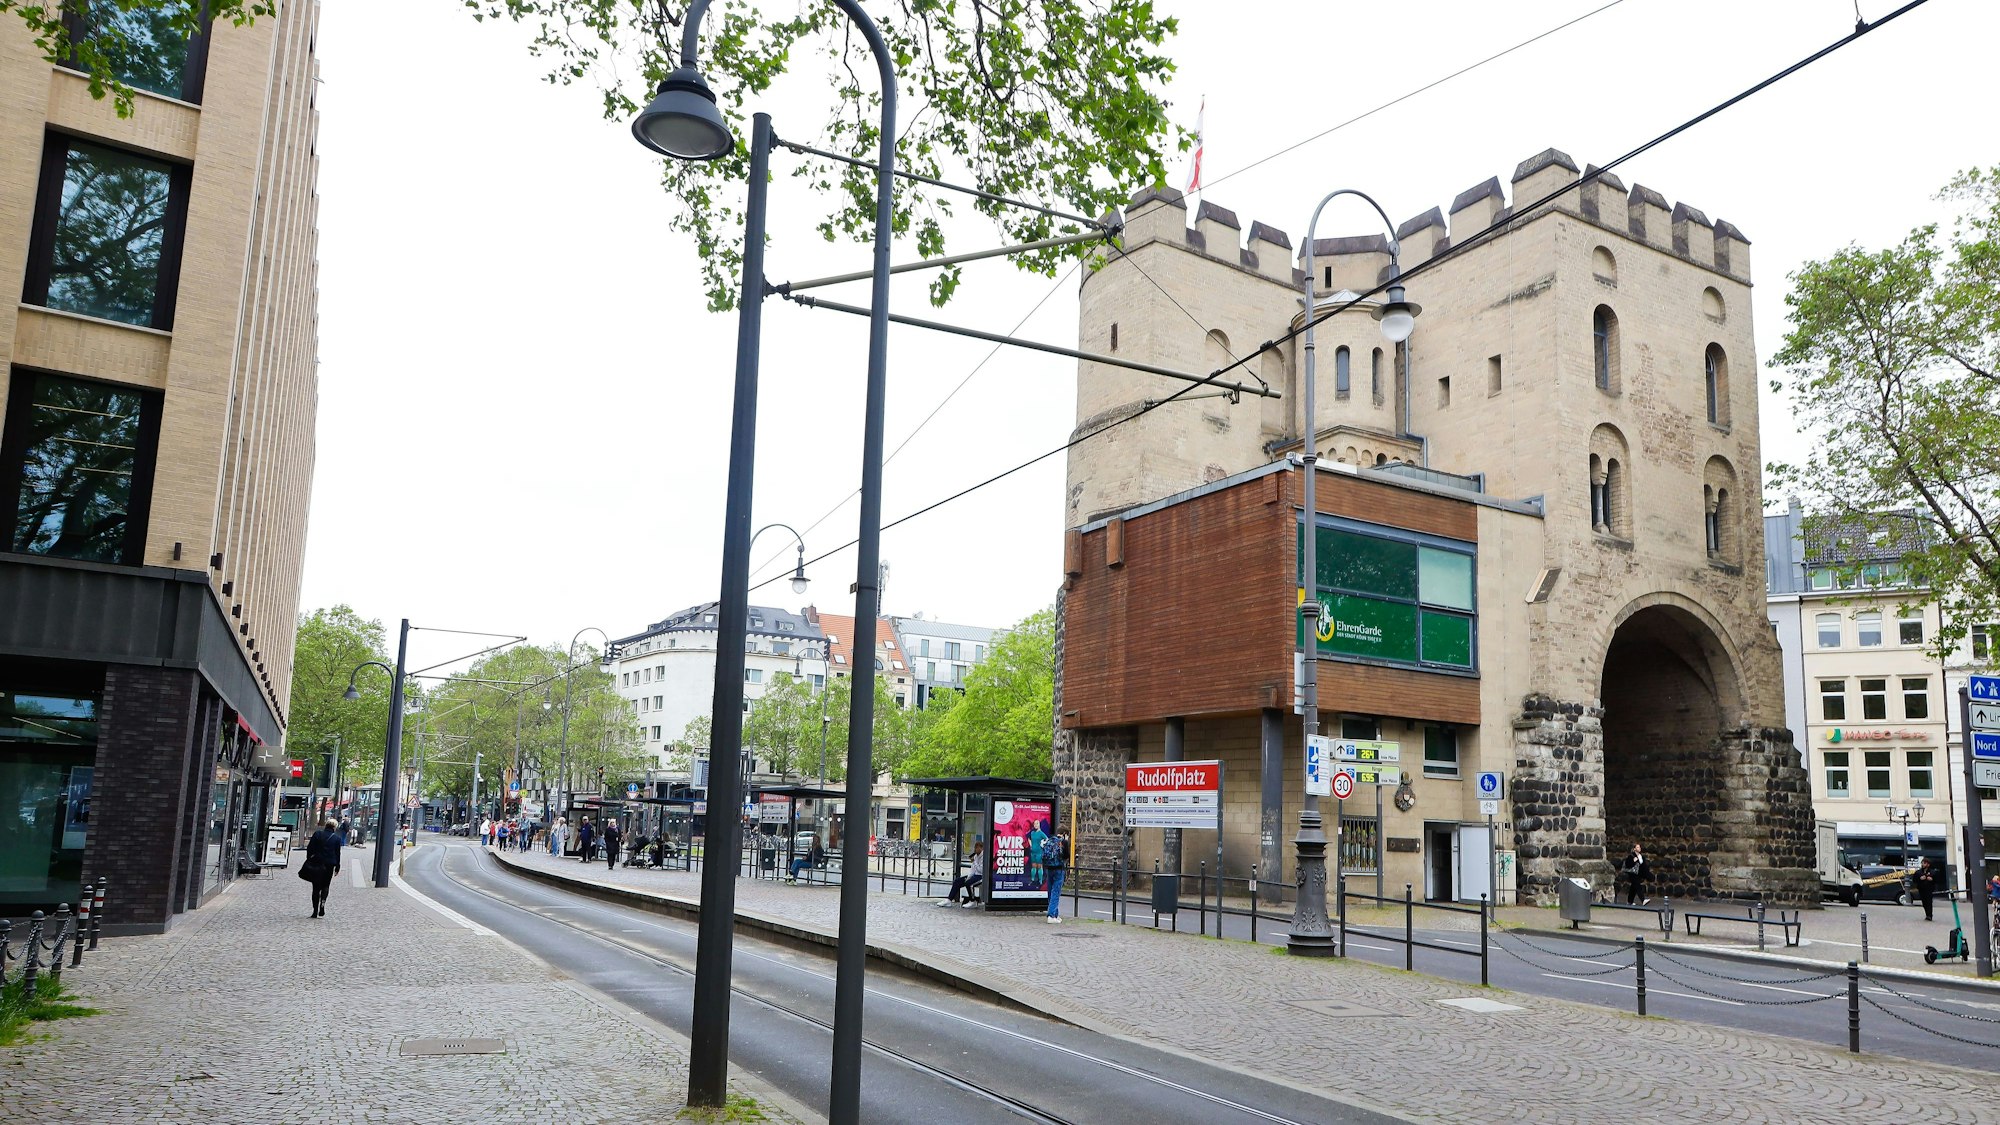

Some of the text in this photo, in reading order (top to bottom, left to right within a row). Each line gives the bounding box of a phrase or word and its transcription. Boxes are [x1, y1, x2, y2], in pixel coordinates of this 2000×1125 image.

[1336, 620, 1382, 636] EhrenGarde
[1844, 730, 1892, 741] MANGO
[1976, 740, 1997, 751] Nord
[1362, 750, 1374, 759] 264
[1137, 768, 1206, 790] Rudolfplatz
[1362, 773, 1374, 782] 695
[1336, 780, 1349, 792] 30
[996, 836, 1024, 848] WIR
[996, 857, 1024, 866] OHNE
